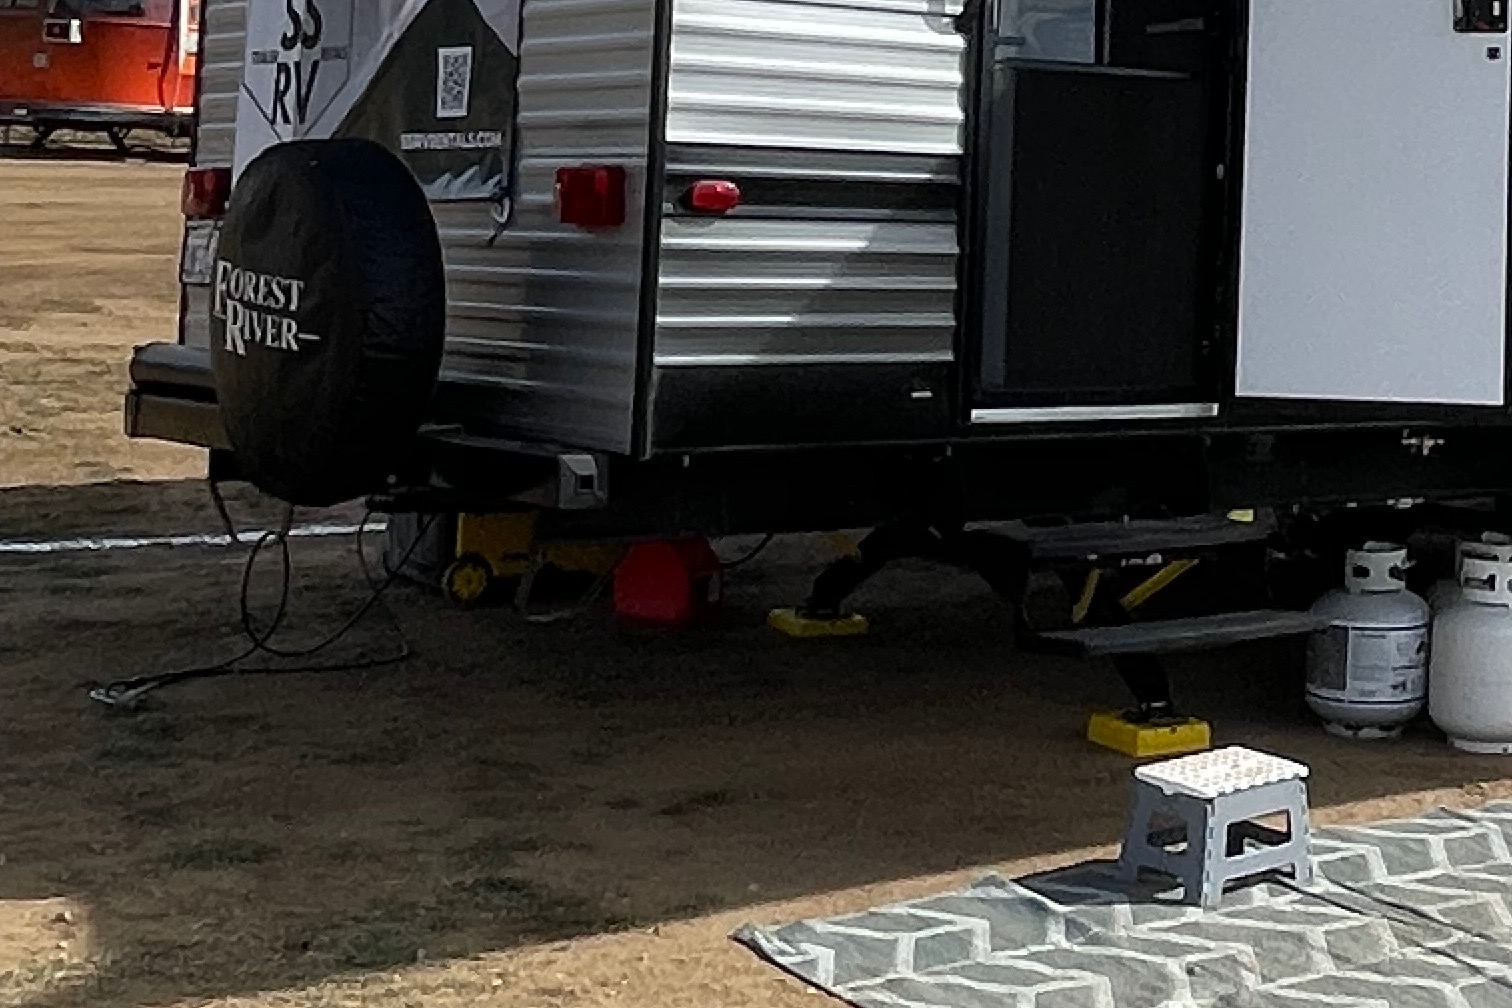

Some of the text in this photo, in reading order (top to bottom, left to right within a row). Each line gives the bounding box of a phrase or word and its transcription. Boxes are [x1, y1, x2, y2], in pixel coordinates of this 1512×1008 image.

[271, 60, 321, 126] RV
[212, 259, 305, 320] FOREST
[225, 298, 300, 356] RIVER
